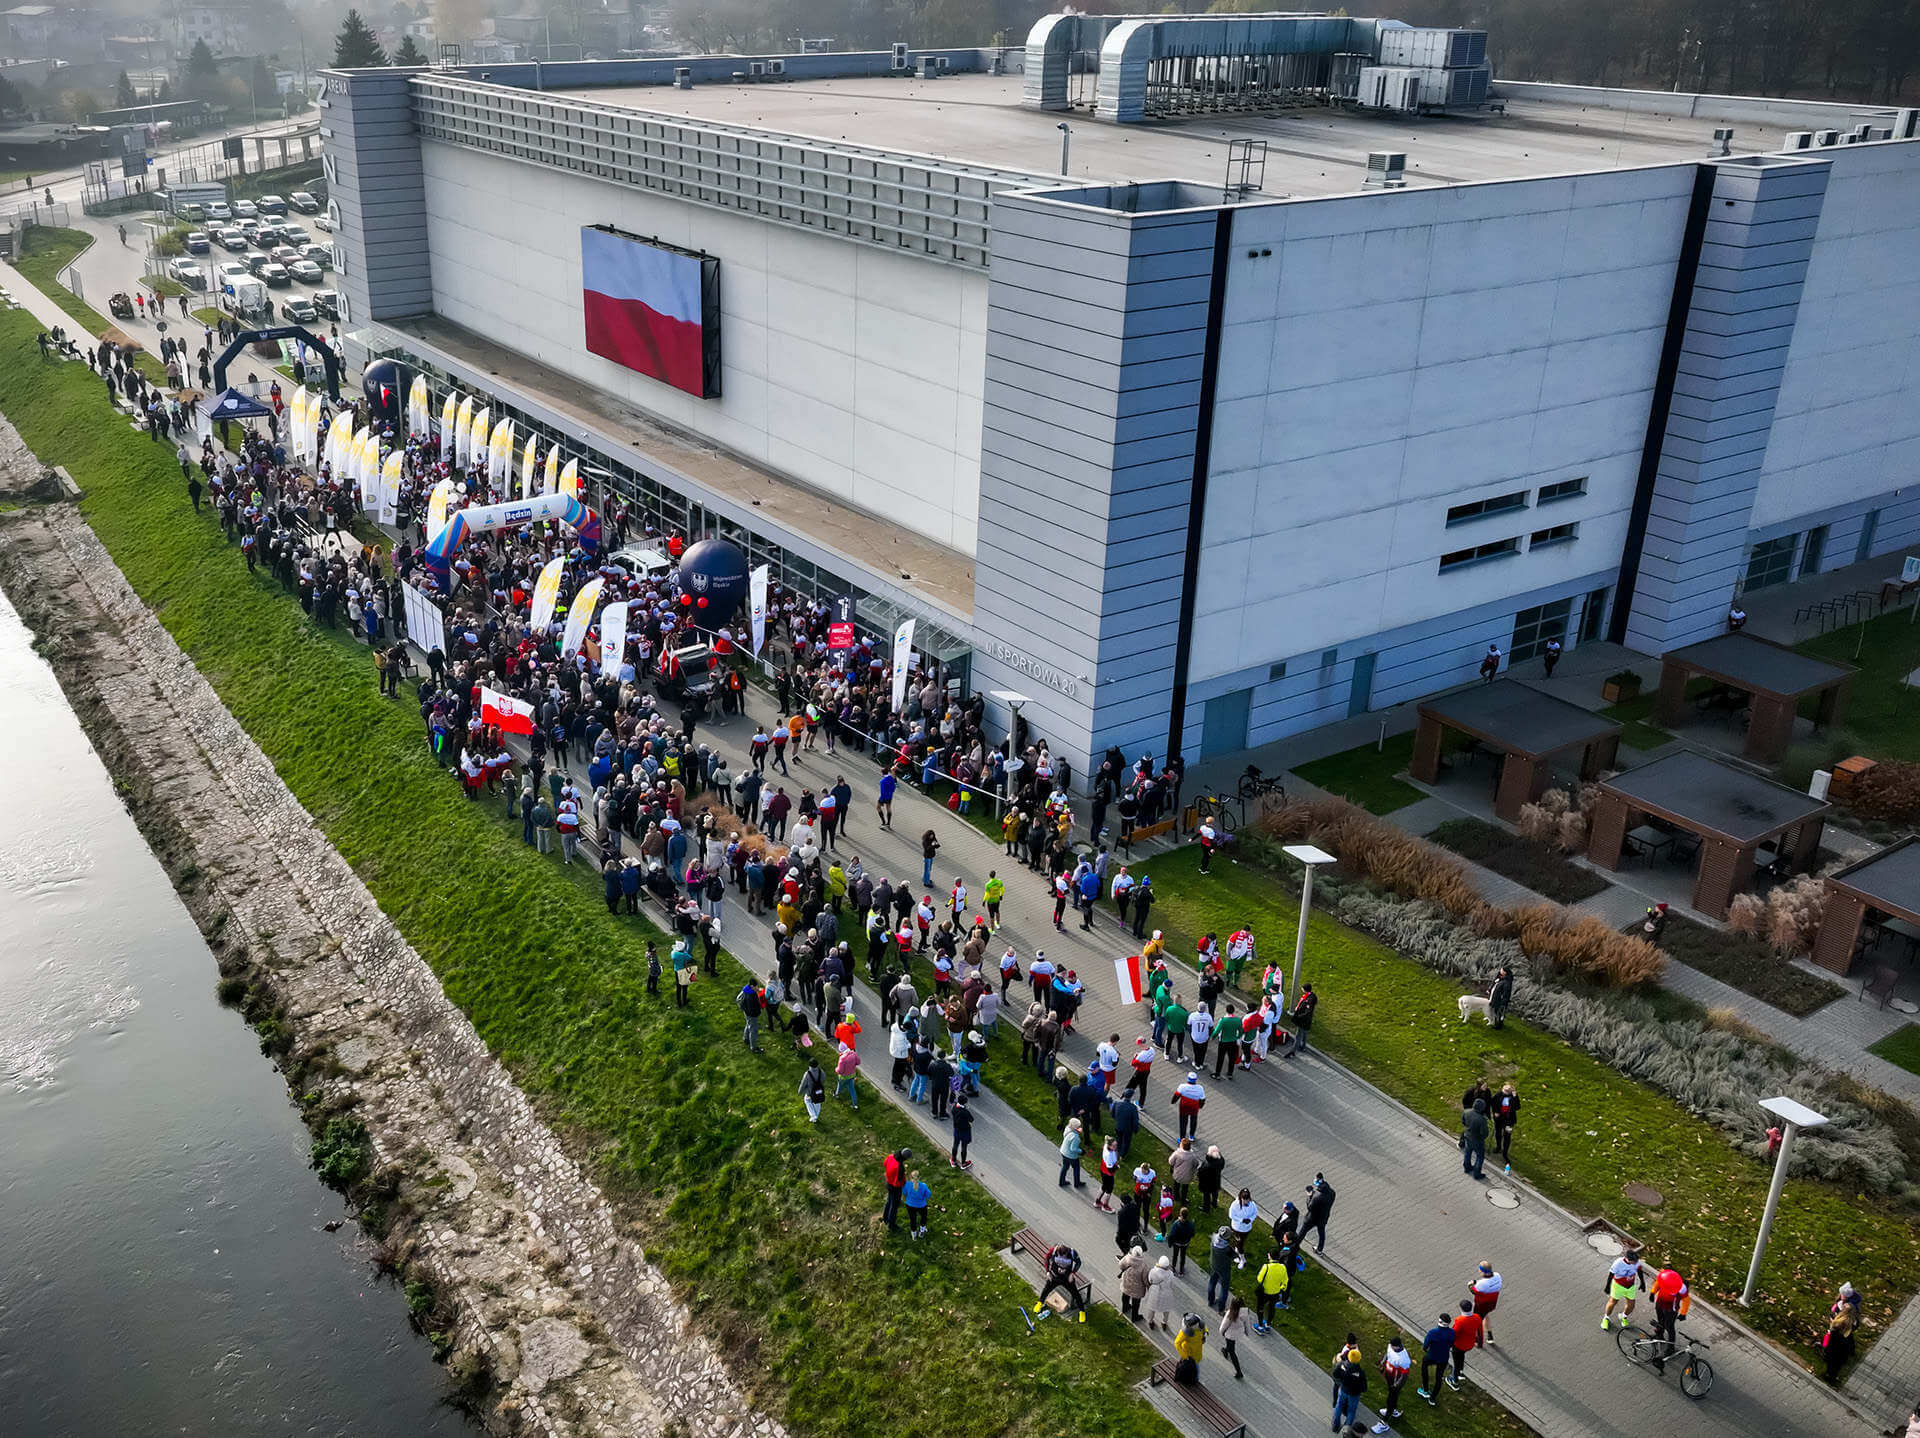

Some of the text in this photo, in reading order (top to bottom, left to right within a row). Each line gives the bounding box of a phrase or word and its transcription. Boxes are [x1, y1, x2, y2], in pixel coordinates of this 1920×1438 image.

[327, 78, 349, 96] ARENA
[505, 510, 531, 520] Będzin
[997, 646, 1060, 687] SPORTOWA
[1062, 679, 1076, 696] 20
[1197, 1023, 1206, 1032] 17
